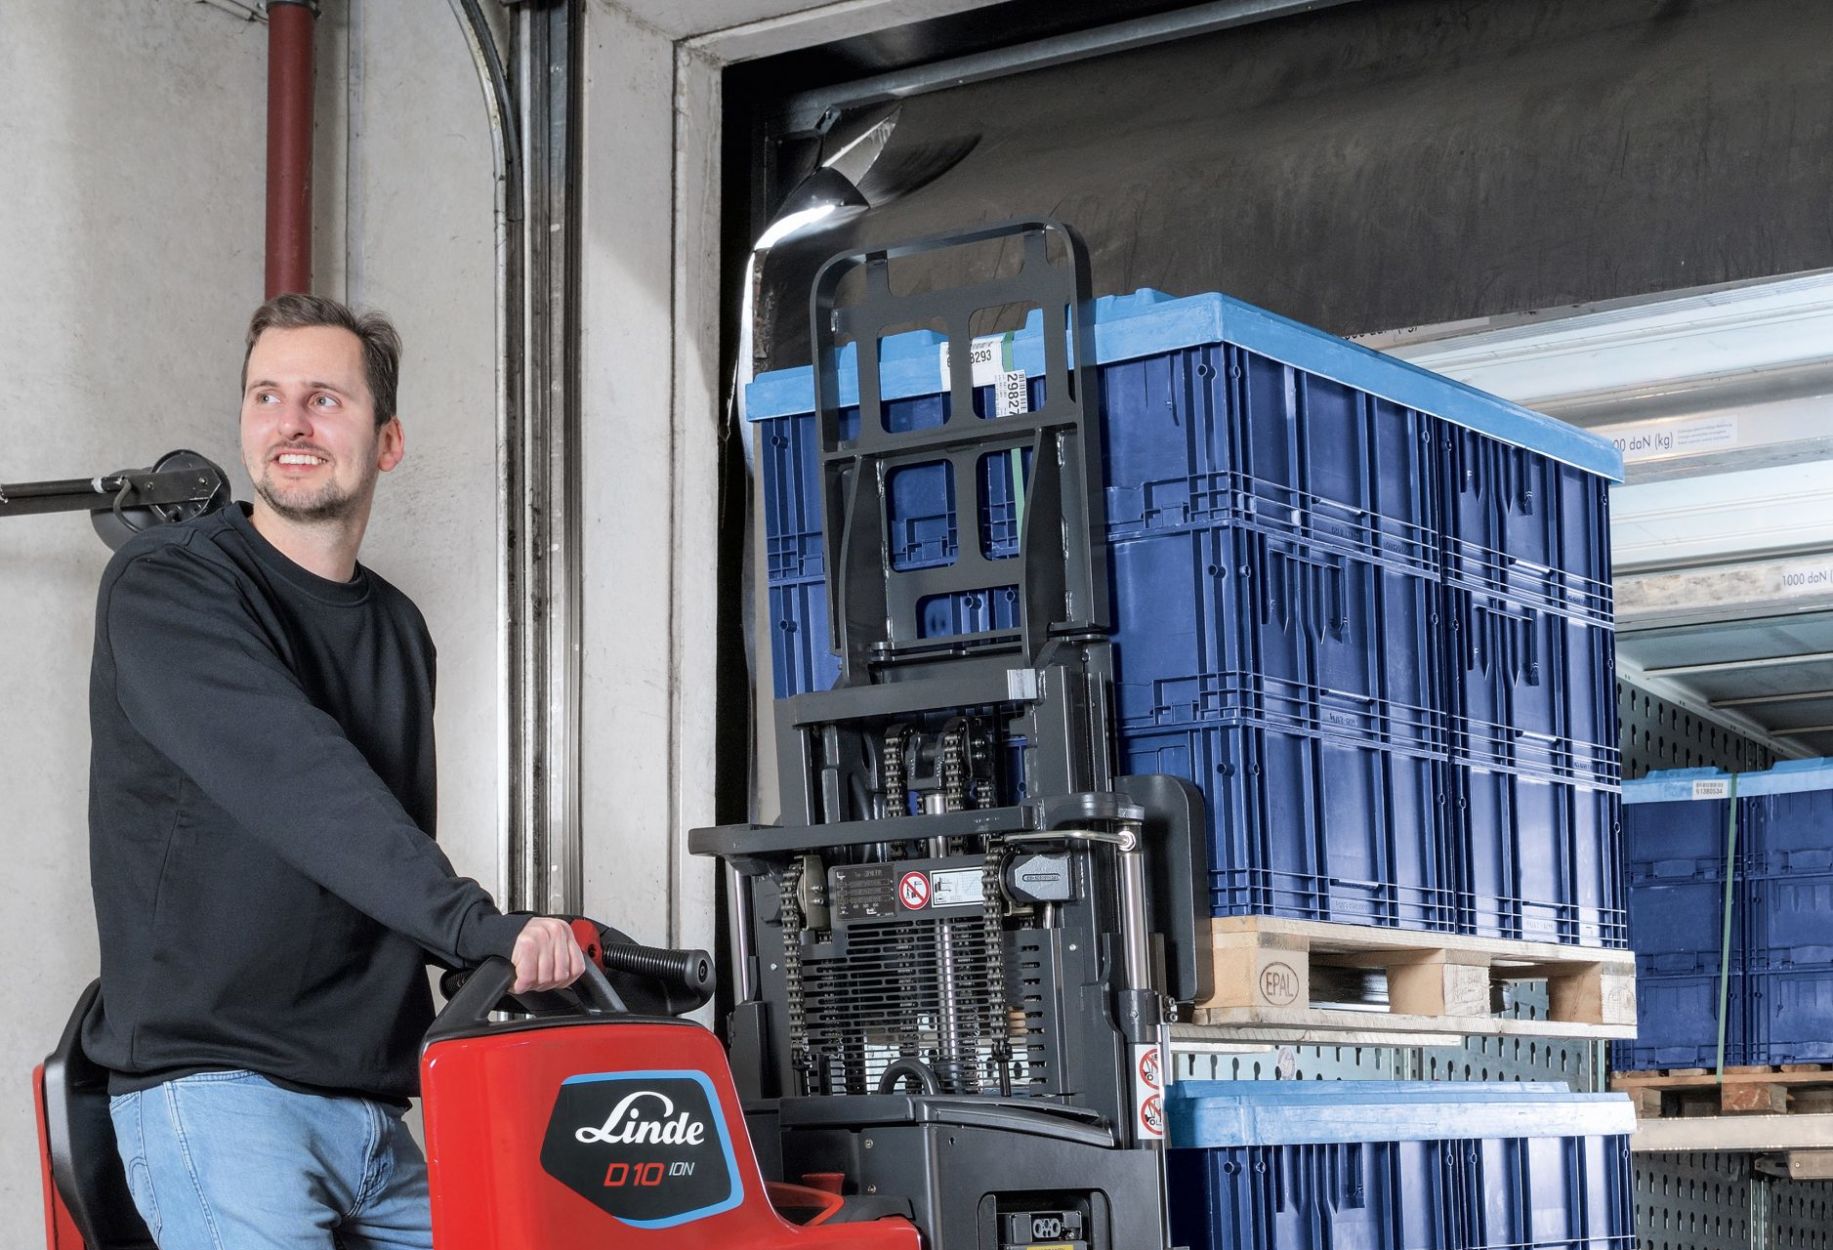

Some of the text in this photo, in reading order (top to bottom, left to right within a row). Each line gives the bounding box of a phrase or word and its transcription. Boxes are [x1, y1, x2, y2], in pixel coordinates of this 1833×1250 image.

[1612, 438, 1626, 452] 00
[1629, 434, 1651, 450] daN
[1655, 432, 1674, 450] (kg)
[1782, 573, 1805, 586] 1000
[1265, 971, 1294, 998] EPAL
[574, 1090, 705, 1146] Linde
[668, 1161, 696, 1177] ION
